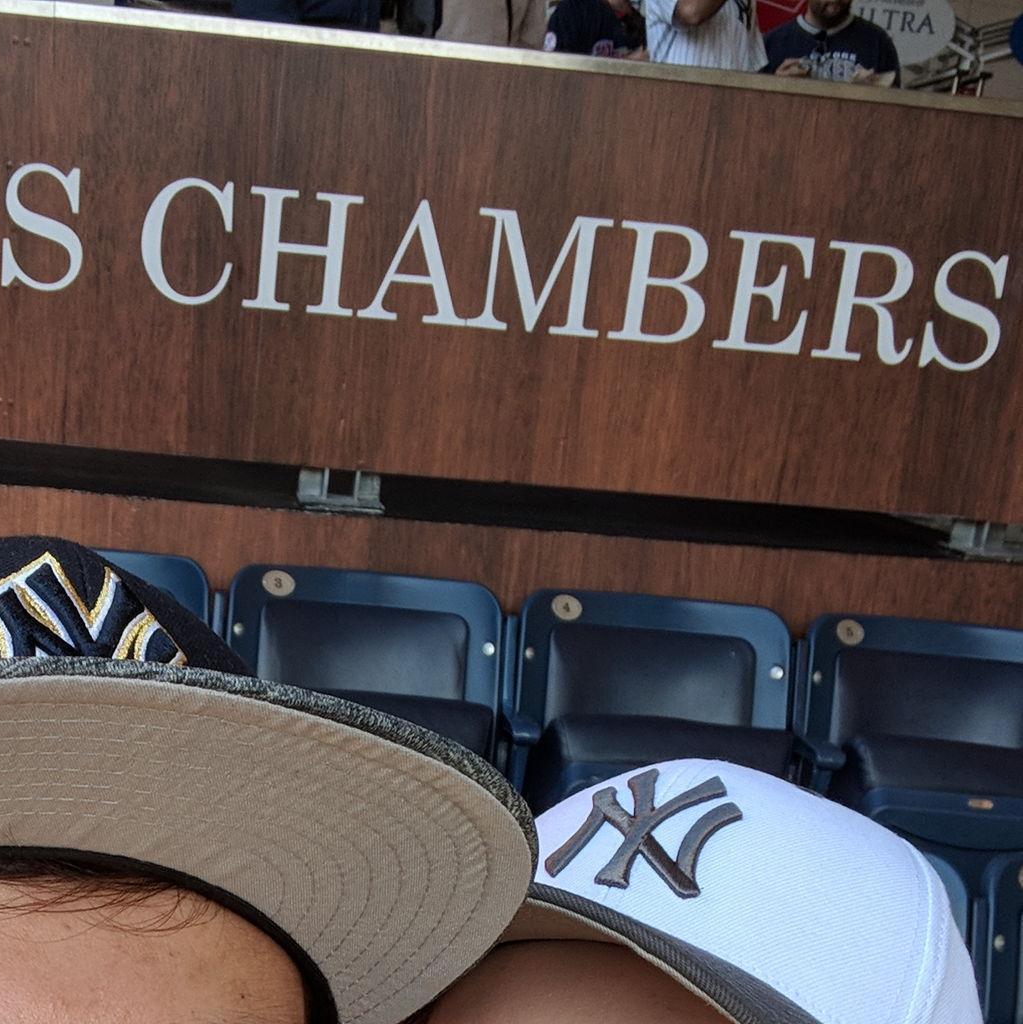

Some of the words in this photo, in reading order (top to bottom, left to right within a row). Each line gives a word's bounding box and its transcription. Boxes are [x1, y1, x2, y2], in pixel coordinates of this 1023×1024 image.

[858, 7, 935, 34] TRA
[140, 177, 1010, 372] CHAMBERS
[544, 768, 744, 900] NY
